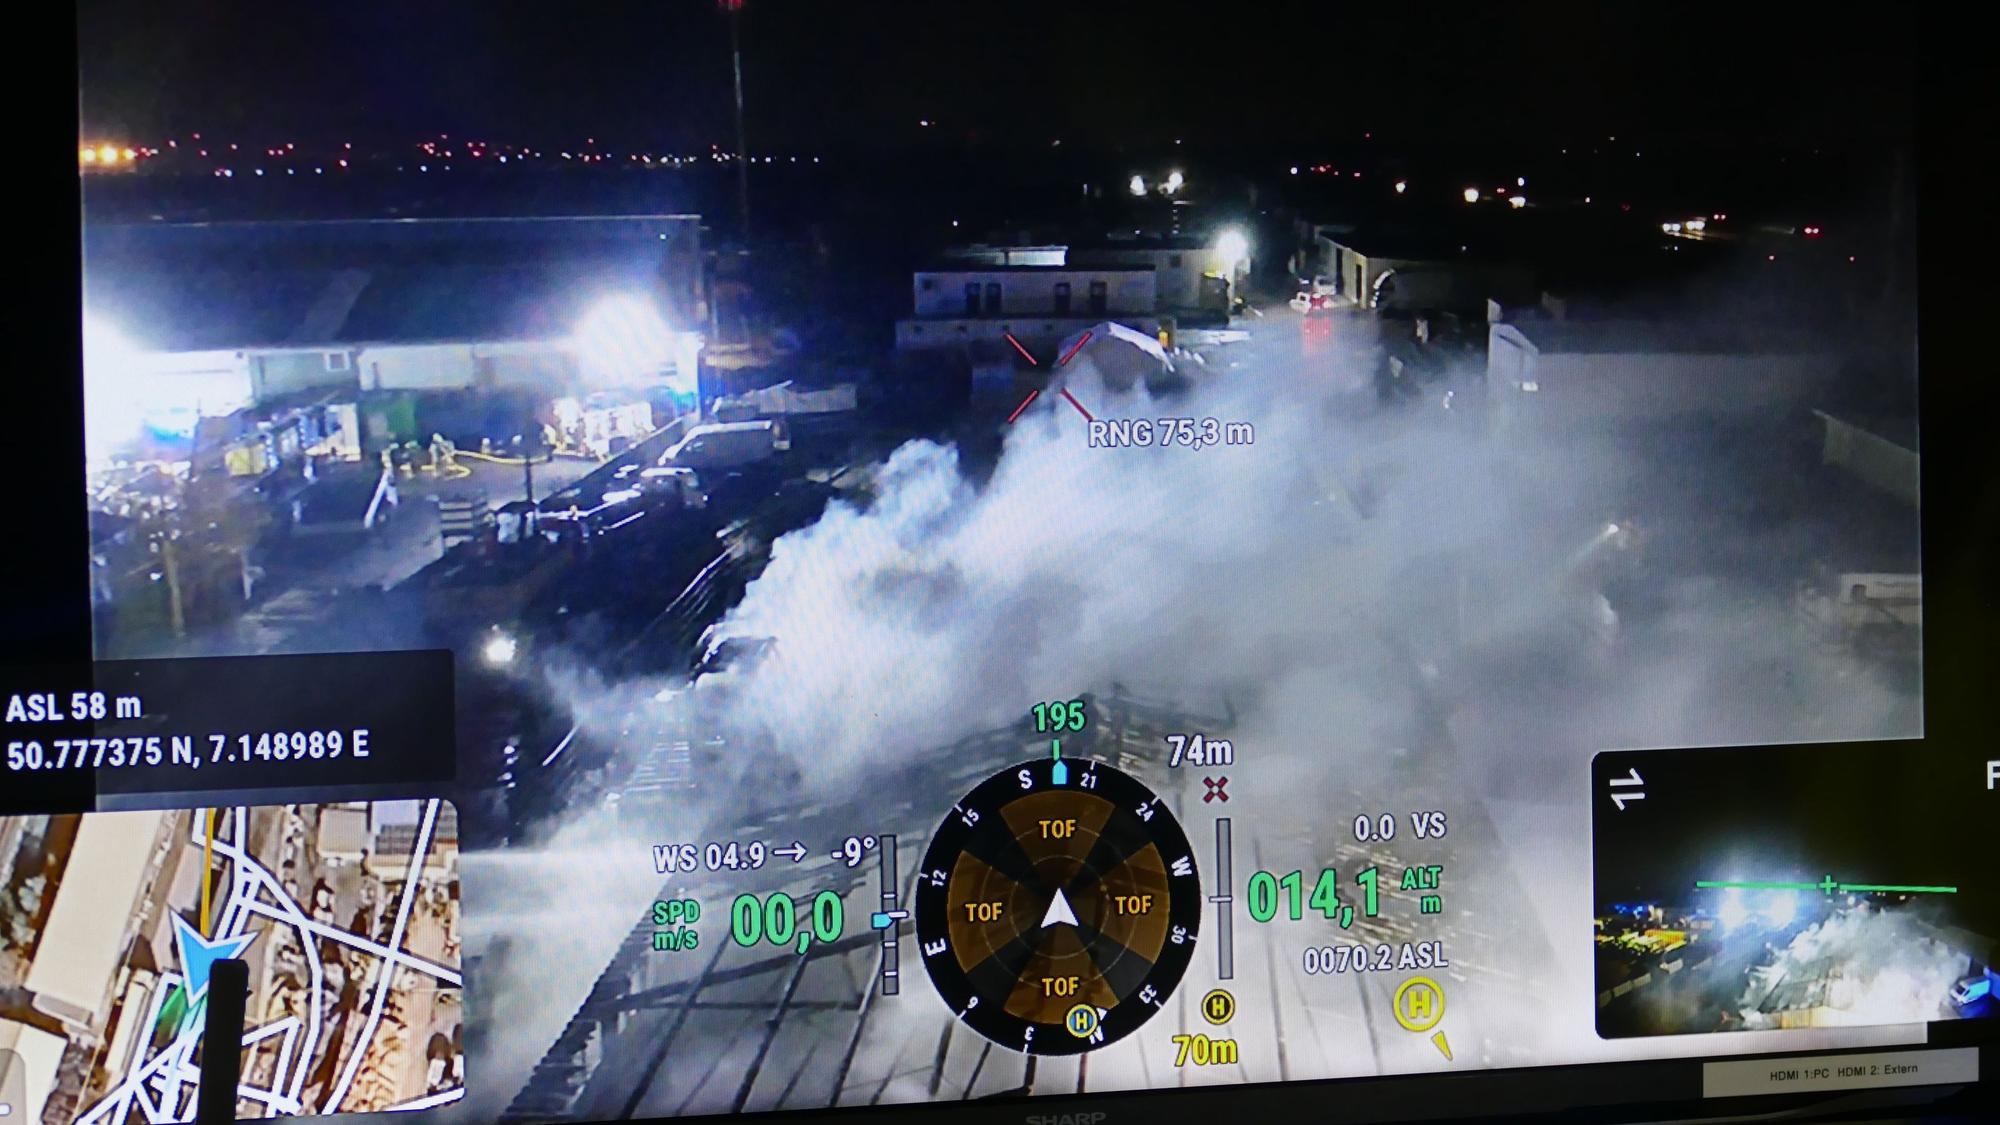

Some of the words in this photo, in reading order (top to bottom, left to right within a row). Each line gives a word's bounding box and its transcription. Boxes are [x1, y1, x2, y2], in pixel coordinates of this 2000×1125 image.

[1088, 419, 1154, 448] RNG
[1158, 417, 1221, 451] 75,3
[1226, 422, 1254, 445] m
[5, 694, 64, 723] ASL
[71, 692, 106, 719] 58
[116, 696, 142, 718] m
[1032, 700, 1086, 732] 195
[7, 736, 162, 771] 50.777375
[171, 736, 200, 770] N,
[208, 731, 343, 764] 7.148989
[352, 729, 370, 758] E
[1166, 734, 1234, 768] 74m
[1017, 769, 1033, 790] S
[1080, 772, 1097, 790] 21
[961, 811, 980, 828] 15
[1135, 803, 1155, 823] 24
[1038, 819, 1077, 840] TOF
[1354, 814, 1395, 842] 0.0
[1411, 811, 1447, 838] VS
[653, 844, 697, 873] WS
[704, 841, 765, 871] 04.9
[831, 836, 877, 868] -9°
[1170, 855, 1193, 877] W
[931, 869, 948, 887] 12
[1400, 866, 1444, 891] ALT
[1114, 895, 1152, 915] TOF
[1247, 867, 1380, 930] 014,1
[1420, 895, 1443, 914] m
[652, 899, 701, 926] SPD
[730, 889, 845, 956] 00,0
[965, 902, 1003, 922] TOF
[652, 925, 699, 951] m/s
[1171, 925, 1187, 945] 30
[924, 937, 946, 957] E
[1303, 944, 1392, 975] 0070.2
[1398, 941, 1449, 970] ASL
[1041, 976, 1080, 997] TOF
[1138, 984, 1157, 1002] 33
[967, 995, 979, 1009] 6
[1024, 1026, 1035, 1041] 3
[1172, 1033, 1237, 1067] 70m
[1770, 1071, 1799, 1081] HDMI
[1804, 1068, 1830, 1079] 1:PC
[1837, 1067, 1866, 1078] HDMI
[1869, 1065, 1880, 1076] 2:
[1884, 1064, 1918, 1075] Extern
[1026, 1112, 1106, 1125] SHARP
